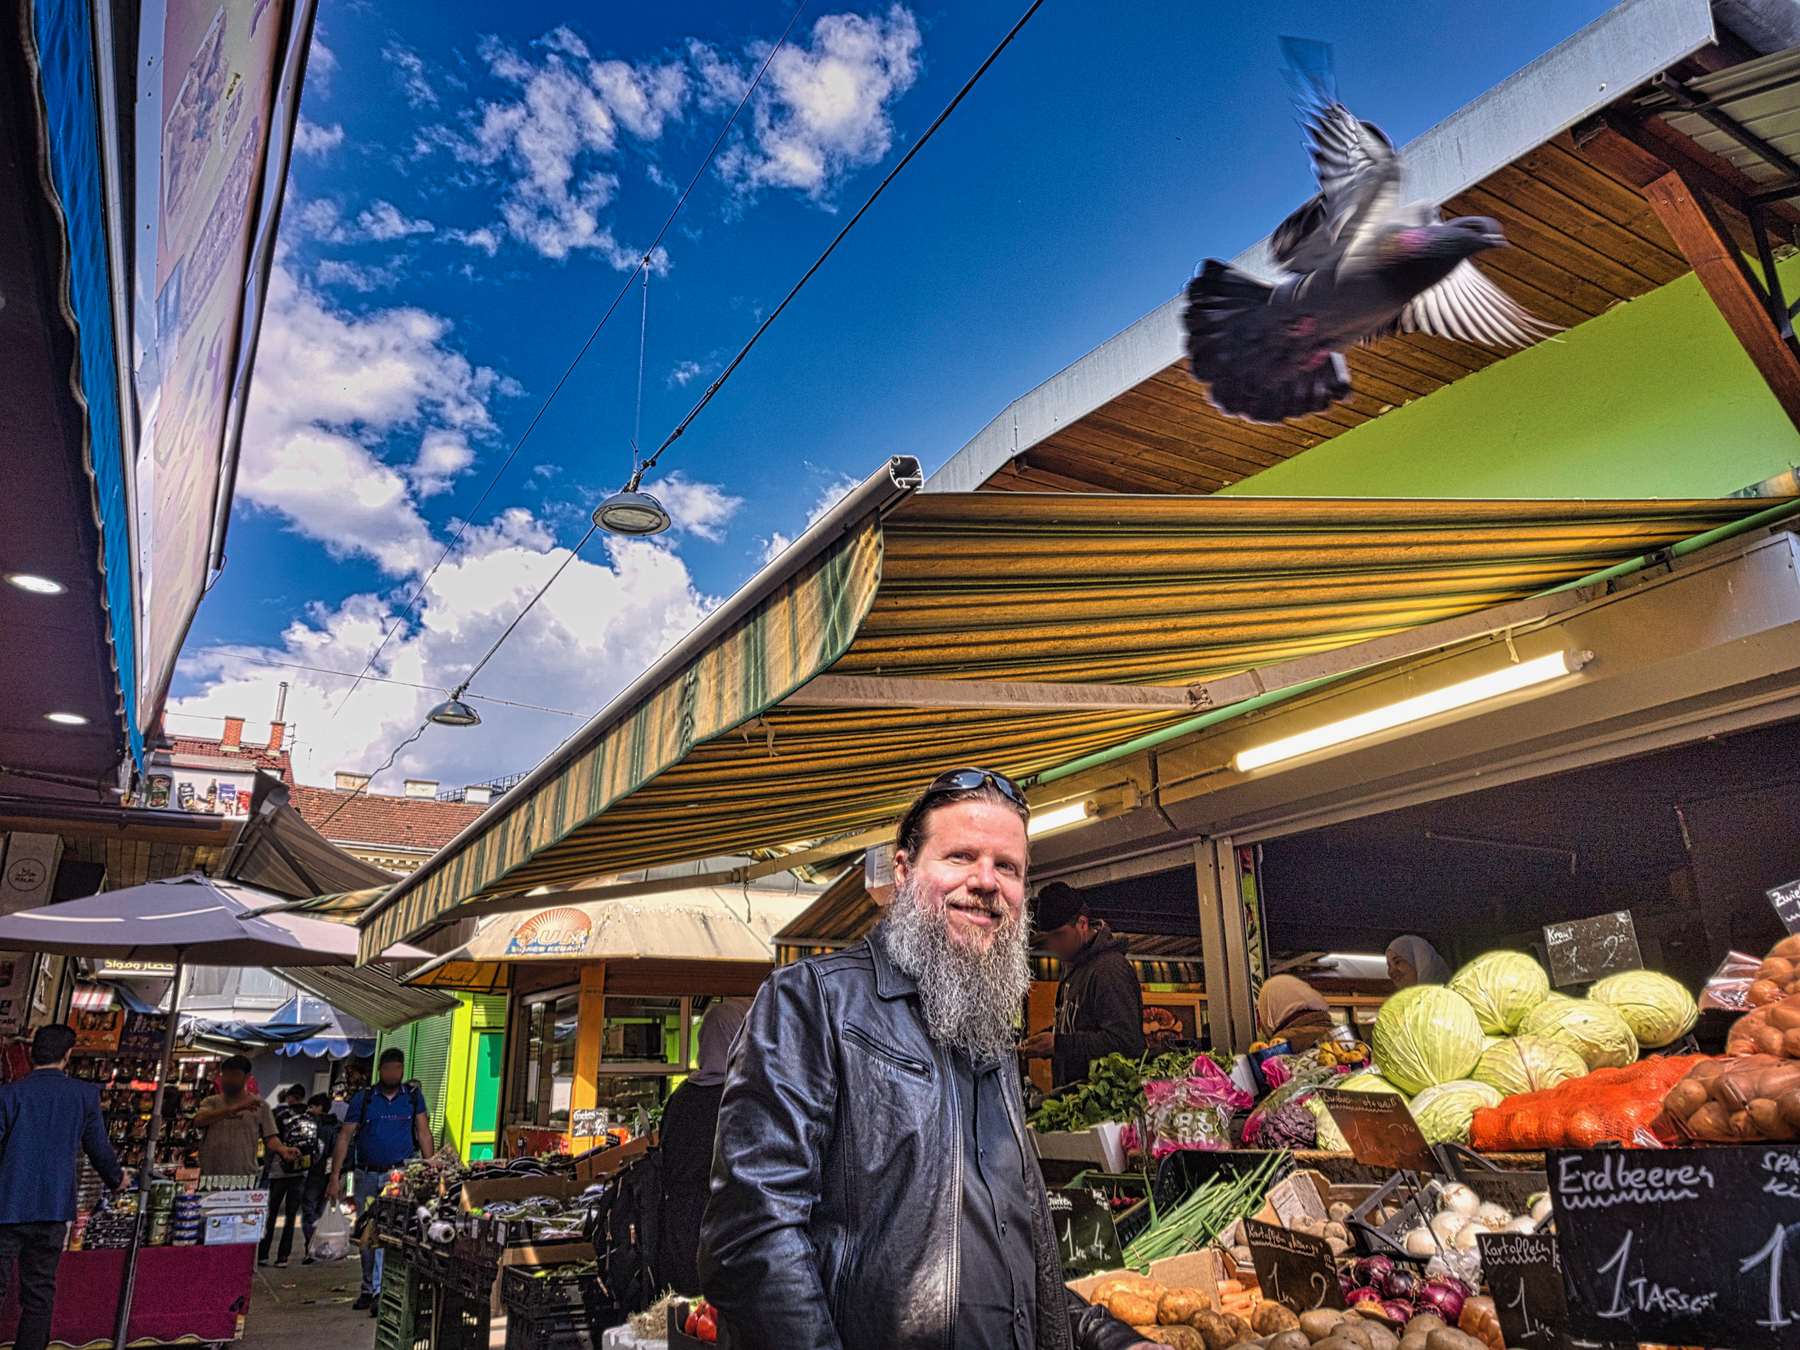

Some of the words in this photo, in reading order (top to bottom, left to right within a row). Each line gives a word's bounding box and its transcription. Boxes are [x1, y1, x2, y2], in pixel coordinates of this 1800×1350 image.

[1772, 884, 1800, 907] Zwie
[1547, 927, 1575, 943] Kraut
[1558, 1154, 1715, 1194] Erdbeeren
[1062, 1217, 1077, 1262] 1
[1481, 1236, 1551, 1263] Kartoffeln
[1268, 1262, 1282, 1303] 1
[1597, 1229, 1634, 1318] 1
[1507, 1276, 1537, 1338] 1
